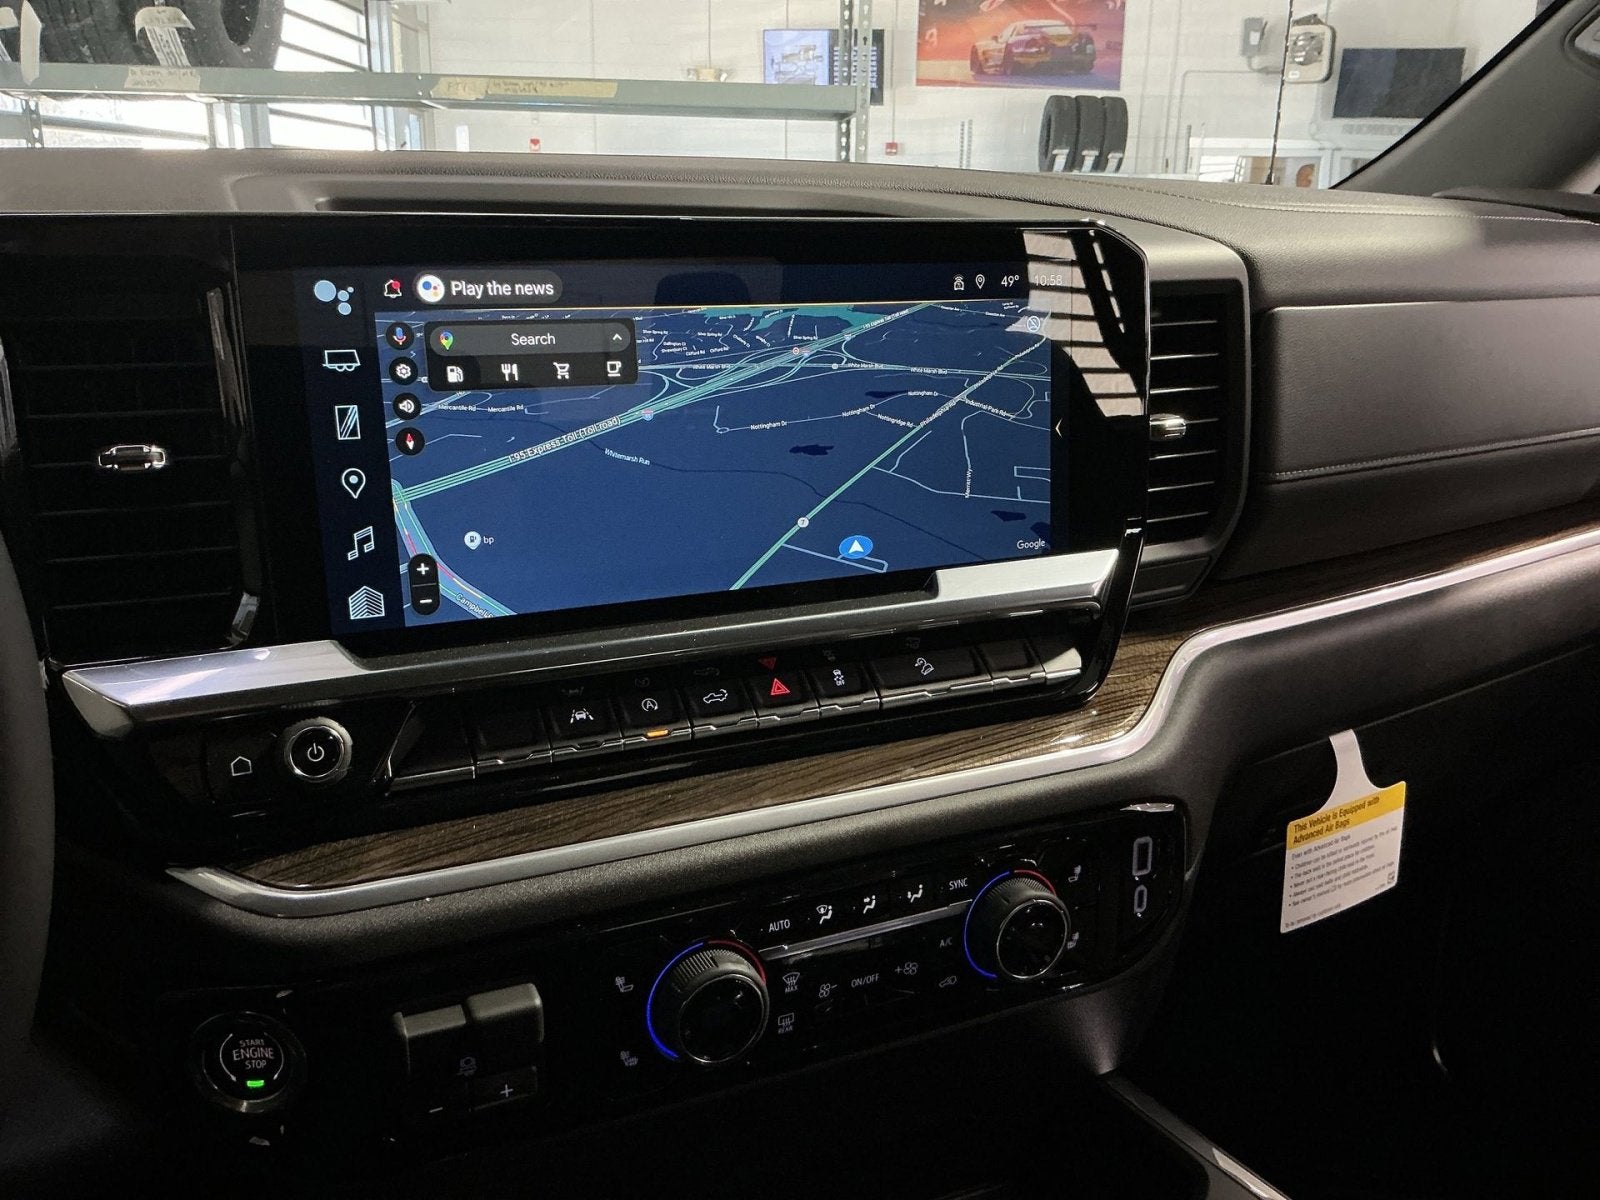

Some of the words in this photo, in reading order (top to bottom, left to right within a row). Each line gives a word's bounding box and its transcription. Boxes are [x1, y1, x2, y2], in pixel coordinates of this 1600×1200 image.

[1034, 274, 1062, 286] 10:58
[450, 280, 484, 300] Play
[486, 280, 512, 296] the
[514, 283, 554, 296] news
[511, 332, 556, 346] Search
[438, 404, 468, 412] Mercantile
[842, 406, 869, 418] Nottingham
[920, 404, 950, 428] Philadelphia
[948, 400, 957, 408] Rd
[966, 399, 987, 410] Industrial
[988, 404, 1000, 414] Park
[999, 408, 1008, 416] Rd
[750, 422, 780, 430] Nottingham
[508, 450, 526, 464] I-95
[526, 439, 560, 457] Express
[560, 432, 578, 444] Toll
[579, 424, 598, 440] (Toll
[598, 416, 621, 432] road)
[604, 448, 638, 463] Whitemarsh
[639, 457, 650, 466] Run
[483, 535, 494, 545] bp
[1016, 538, 1046, 550] Google
[456, 593, 488, 618] Campbell
[1293, 822, 1308, 834] This
[1309, 813, 1331, 828] Vehicle
[1332, 811, 1338, 820] is
[1339, 801, 1366, 819] Equipped
[1367, 796, 1380, 808] with
[1293, 827, 1324, 844] Advanced
[1324, 823, 1334, 834] Air
[1335, 818, 1350, 830] Bags
[948, 877, 969, 891] SYNC
[768, 919, 791, 933] AUTO
[939, 936, 954, 948] A/C
[851, 973, 880, 988] ON/OFF
[239, 1038, 264, 1047] START
[232, 1047, 274, 1061] ENGINE
[245, 1060, 267, 1070] STOP
